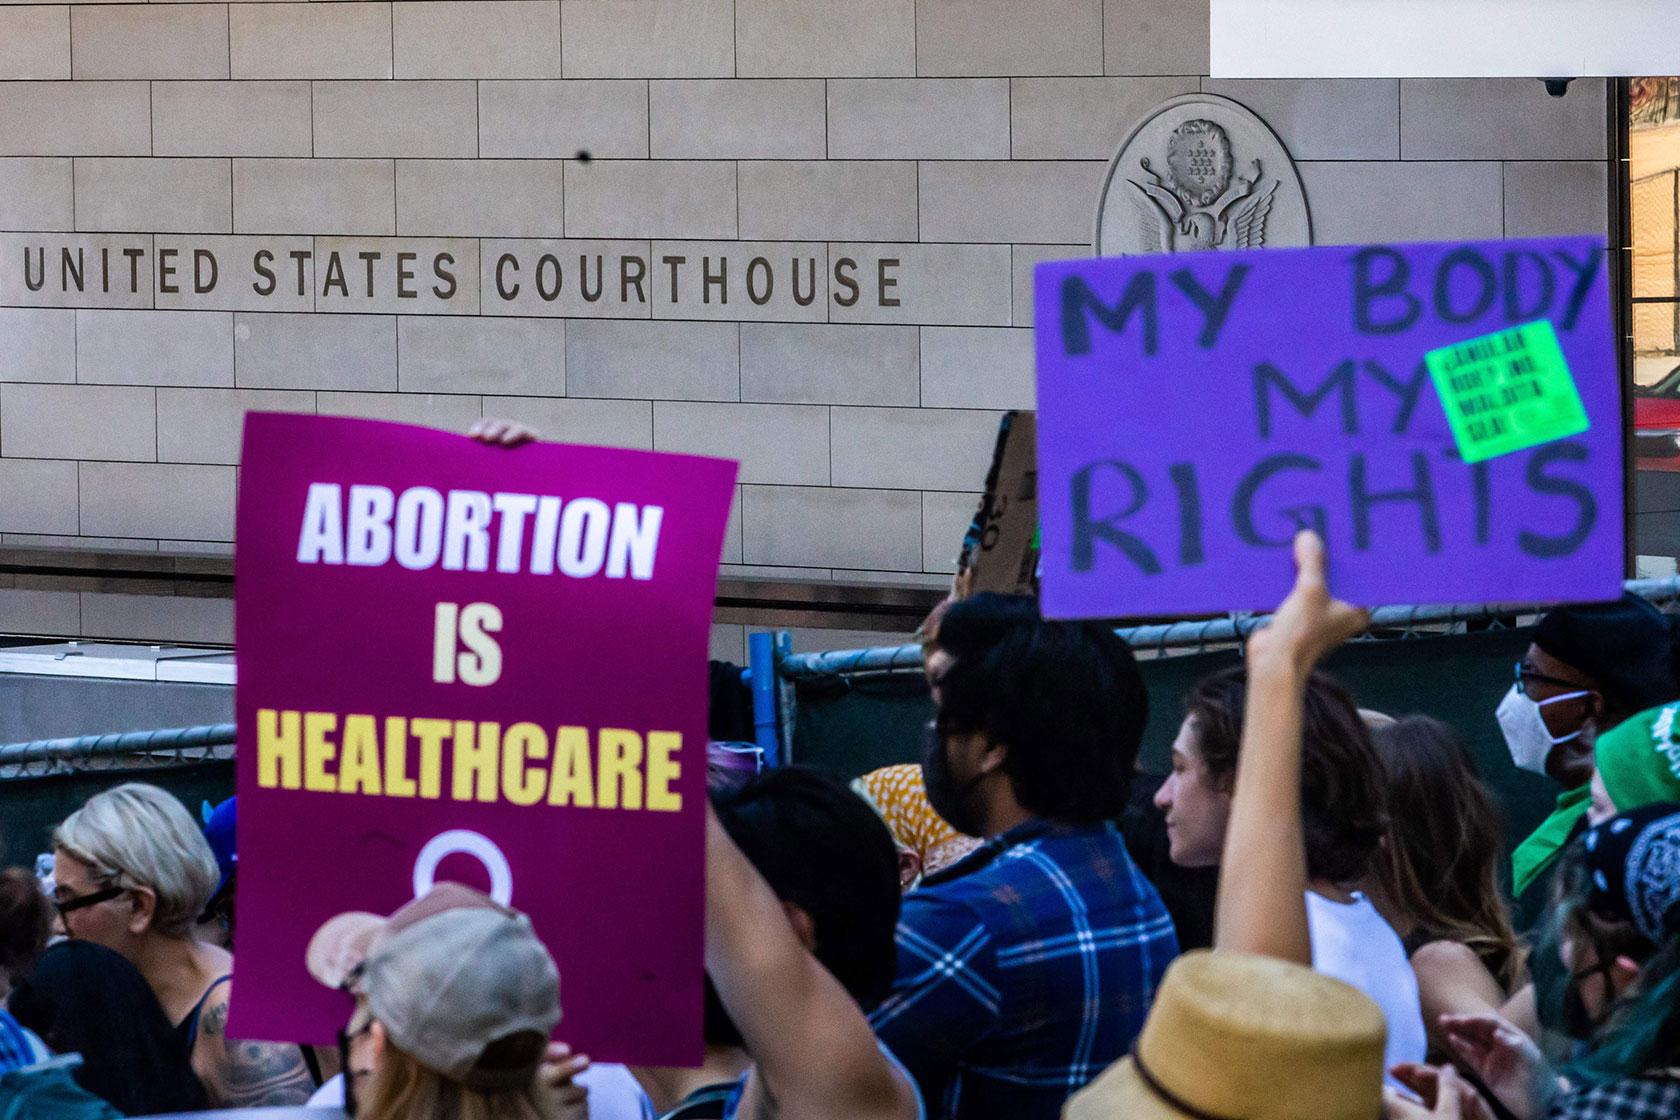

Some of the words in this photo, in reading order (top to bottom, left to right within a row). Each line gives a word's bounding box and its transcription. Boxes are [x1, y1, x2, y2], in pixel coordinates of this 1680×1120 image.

[24, 246, 218, 294] UNITED
[252, 249, 457, 300] STATES
[495, 253, 901, 307] COURTHOUSE
[1060, 263, 1251, 357] MY
[1348, 243, 1603, 336] BODY
[1254, 357, 1428, 441] MY
[296, 482, 664, 581] ABORTION
[1070, 442, 1598, 576] RIGHTS
[432, 601, 504, 687] IS
[256, 708, 684, 812] HEALTHCARE
